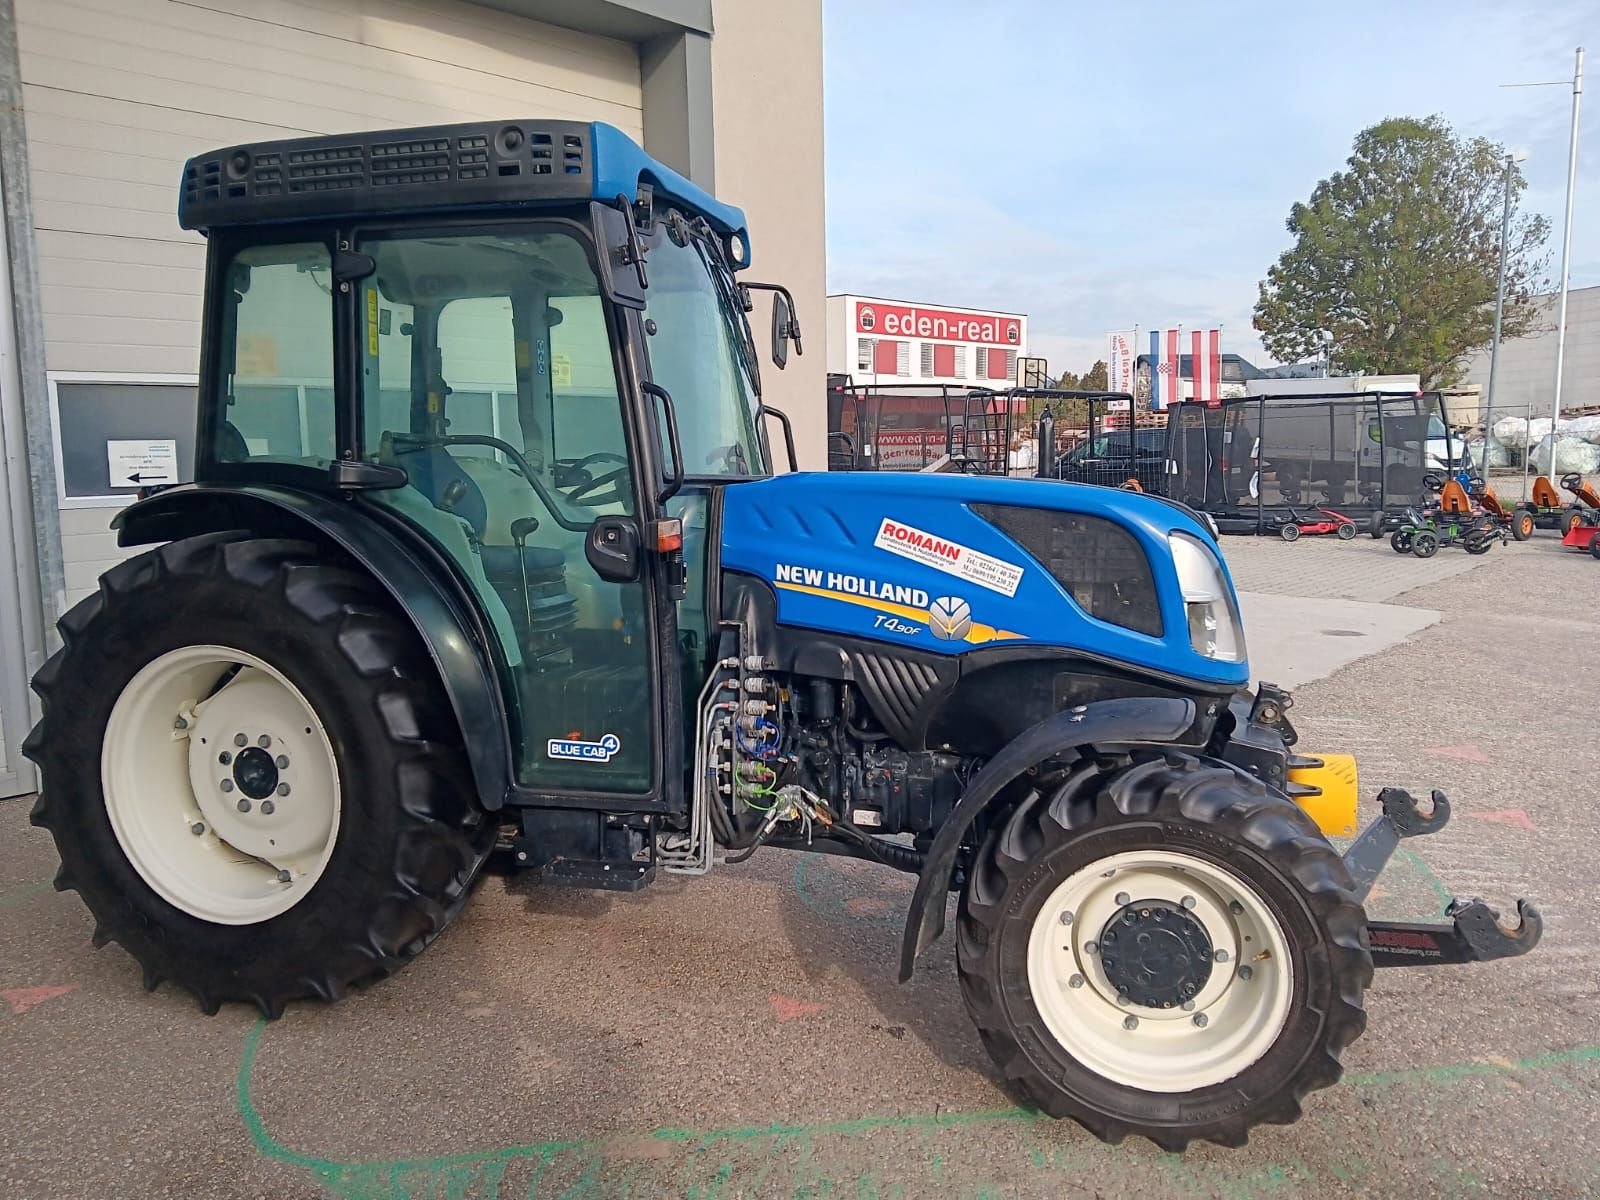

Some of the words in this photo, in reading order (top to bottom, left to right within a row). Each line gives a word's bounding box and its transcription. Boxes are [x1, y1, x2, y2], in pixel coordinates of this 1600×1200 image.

[884, 309, 1000, 342] eden-real
[881, 535, 912, 549] Landtechnik
[917, 547, 956, 565] Nutzfahrzeuge
[883, 523, 961, 560] ROMANN
[776, 563, 824, 587] NEW
[827, 572, 929, 607] HOLLAND
[551, 743, 580, 755] BLUE
[583, 746, 606, 758] CAB
